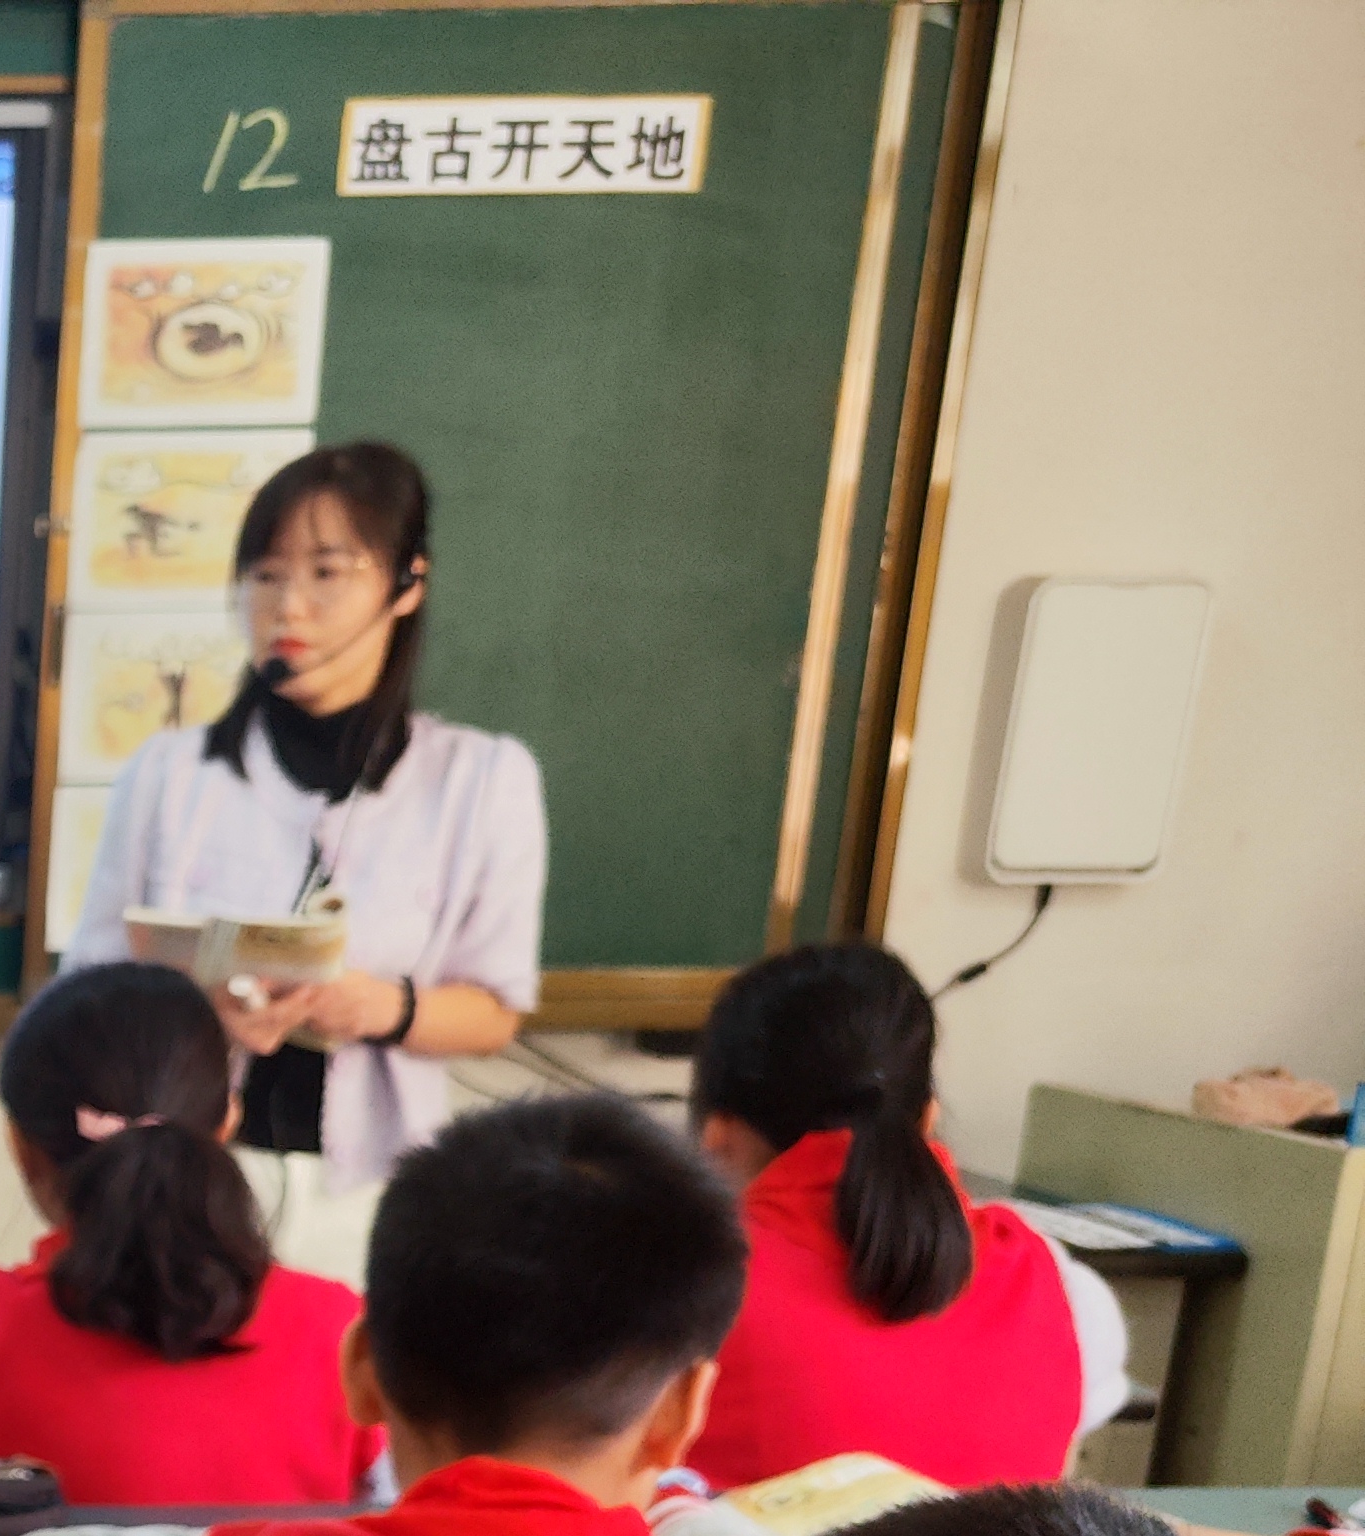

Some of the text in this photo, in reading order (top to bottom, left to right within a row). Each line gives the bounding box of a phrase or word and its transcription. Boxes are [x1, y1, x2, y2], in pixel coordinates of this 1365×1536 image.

[202, 107, 300, 193] 12
[350, 116, 688, 187] 盘古开天地
